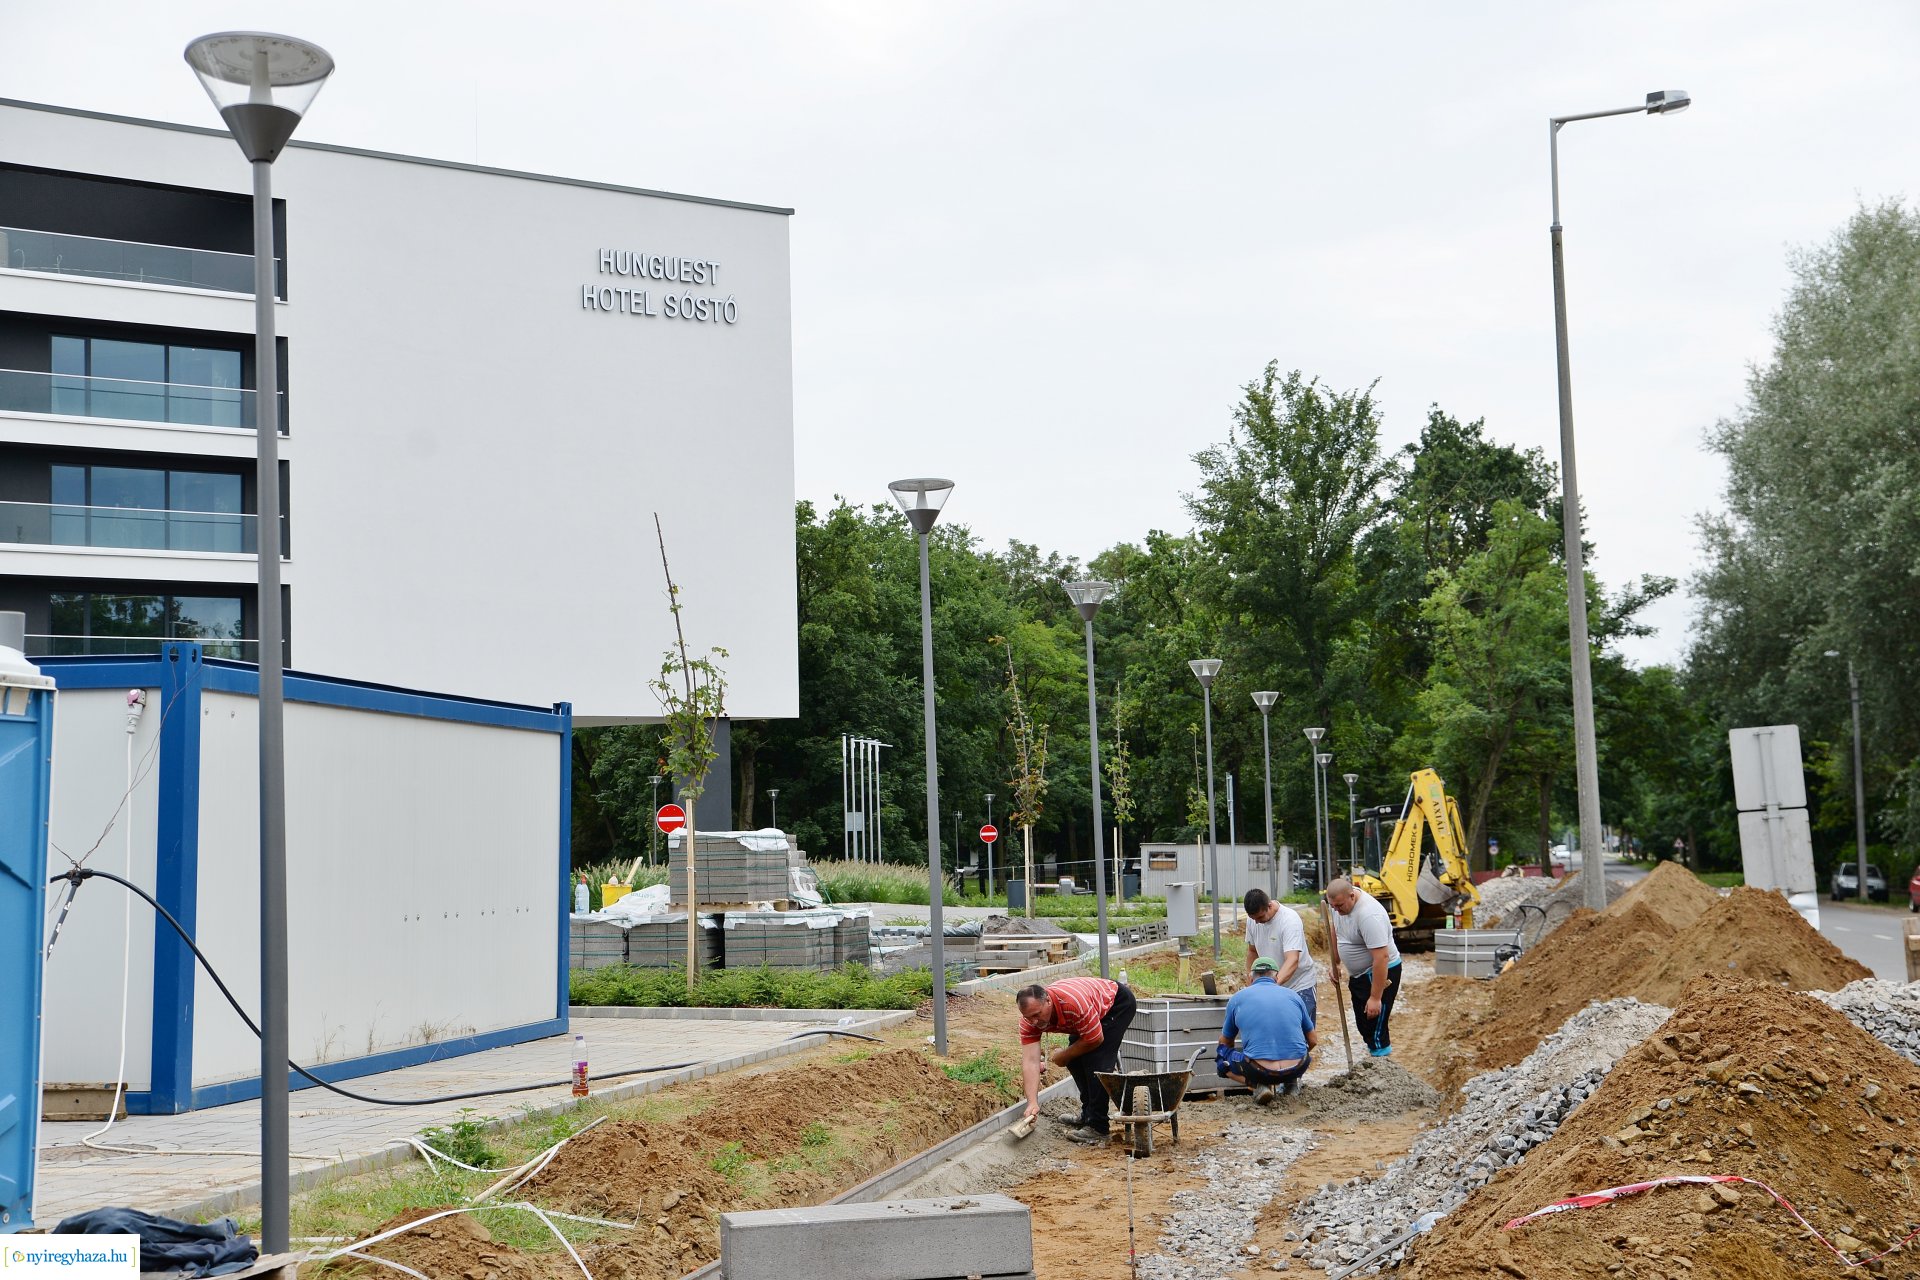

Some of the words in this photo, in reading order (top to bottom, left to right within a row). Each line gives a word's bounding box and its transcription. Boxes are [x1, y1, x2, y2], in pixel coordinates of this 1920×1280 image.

[599, 248, 721, 285] HUNGUEST
[582, 284, 658, 316] HOTEL
[664, 289, 738, 324] SÓSTÓ
